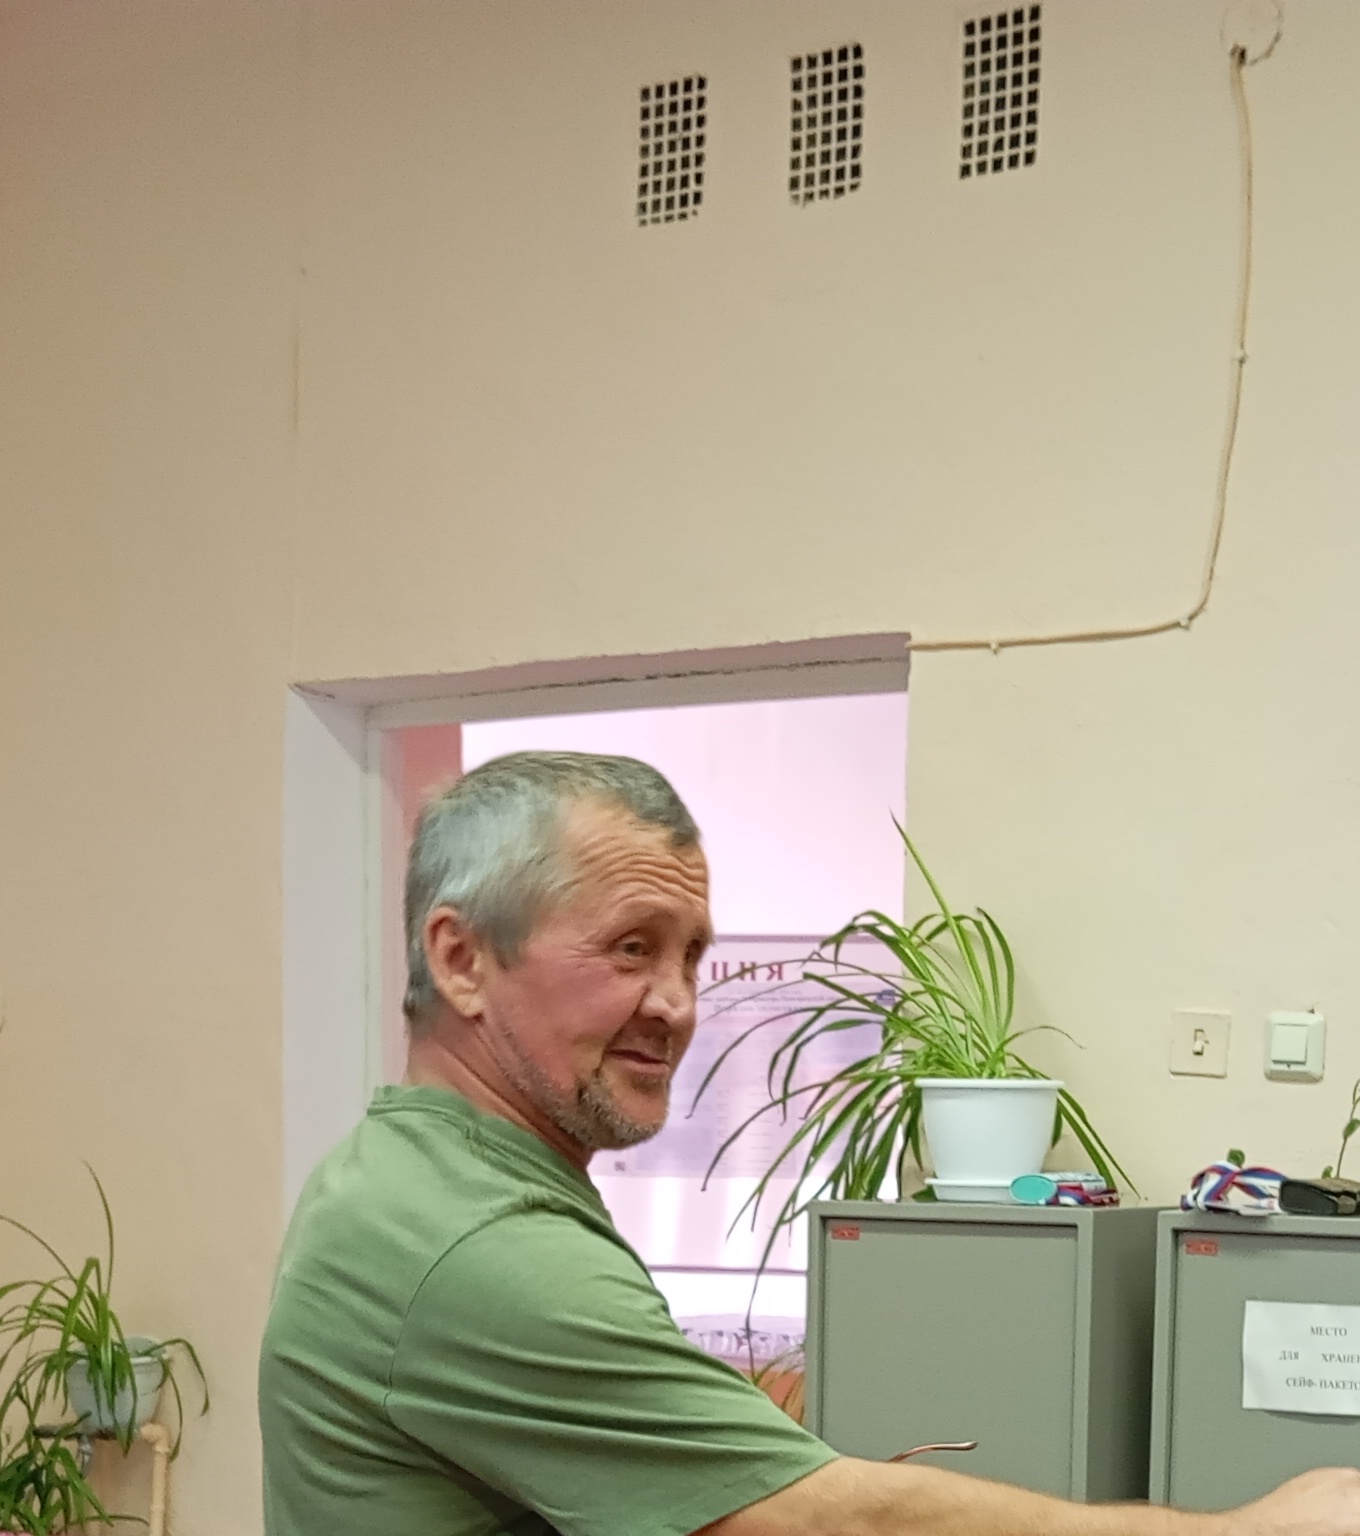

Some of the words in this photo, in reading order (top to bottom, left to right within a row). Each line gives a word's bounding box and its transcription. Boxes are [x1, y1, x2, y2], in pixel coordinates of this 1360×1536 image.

[698, 961, 784, 982] ЦИЯ
[1310, 1325, 1348, 1337] МЕСТО
[1279, 1350, 1300, 1361] ДЛЯ
